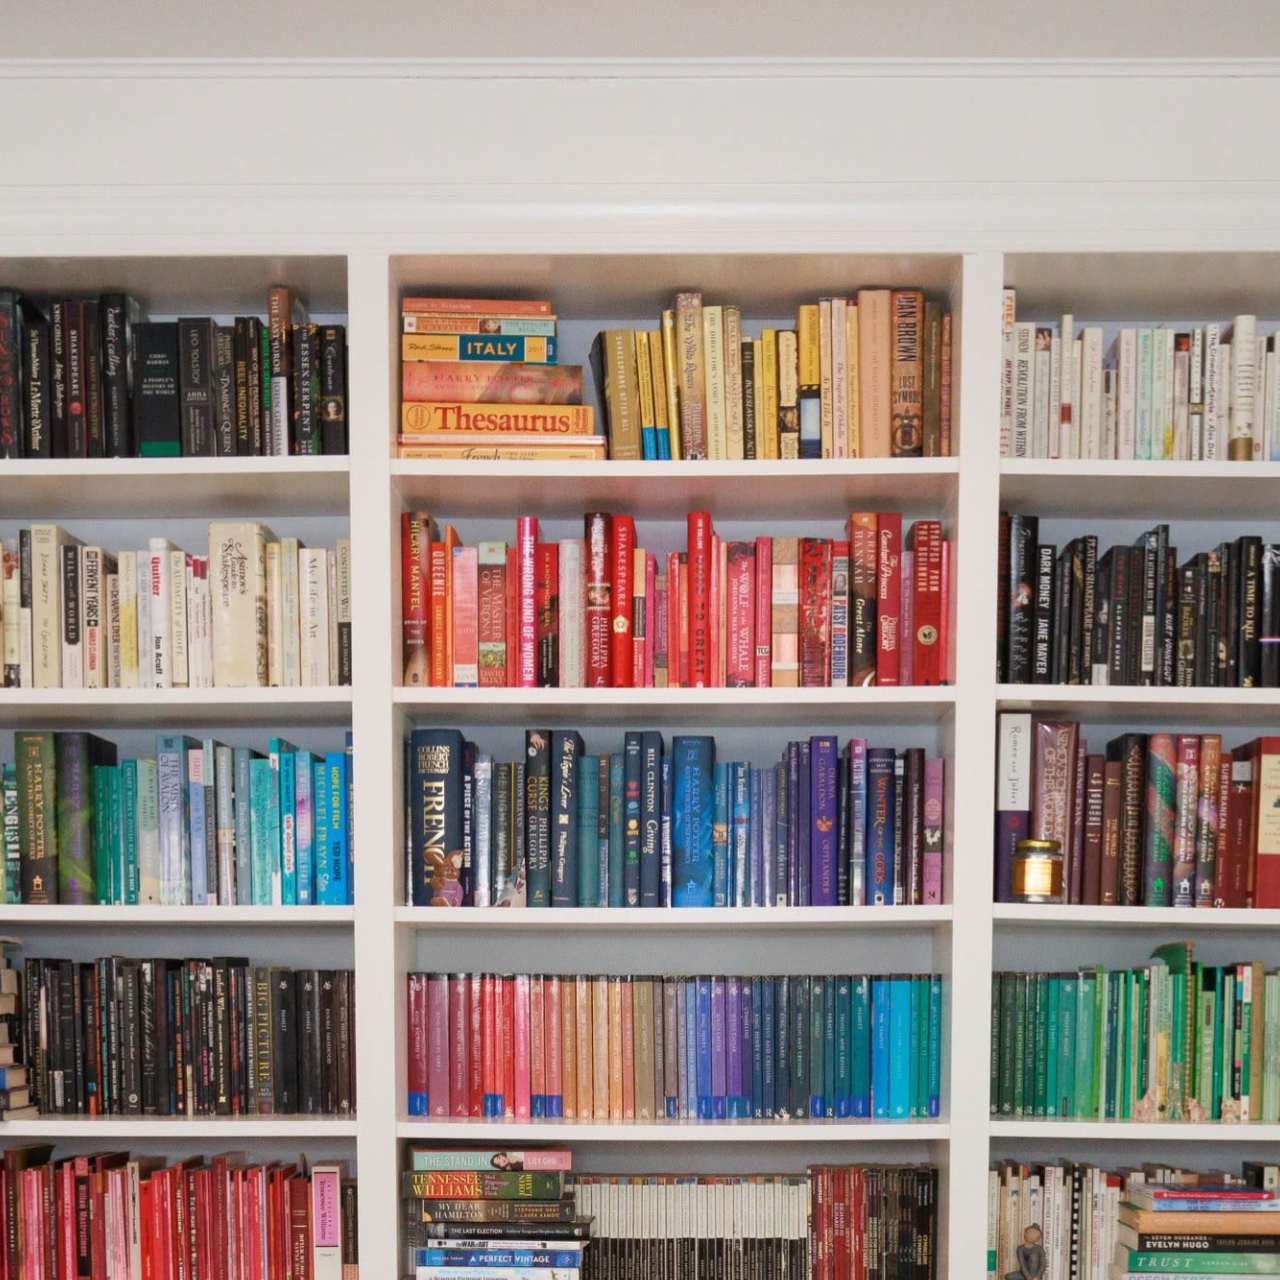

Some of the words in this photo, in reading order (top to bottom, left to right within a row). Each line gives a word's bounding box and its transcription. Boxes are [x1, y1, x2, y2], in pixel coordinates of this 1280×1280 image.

[898, 296, 917, 319] DAN
[190, 329, 200, 346] LEO
[272, 317, 280, 343] LAST
[897, 322, 918, 363] BROWN
[70, 330, 80, 397] SHAKESPEARE
[272, 344, 281, 375] JUROR
[301, 343, 312, 378] ESSEX
[466, 341, 518, 356] ITALY
[191, 349, 201, 385] TOLSTOY
[237, 361, 248, 384] REEL
[1016, 359, 1030, 404] REVOLUTION
[238, 387, 249, 441] INEQUALITY
[302, 381, 313, 433] SERPENT
[434, 405, 570, 434] Thesaurus
[1016, 407, 1029, 429] FROM
[1014, 430, 1028, 459] WITHIN
[410, 520, 421, 560] HILARY
[1085, 538, 1097, 571] PLAYING
[67, 551, 77, 581] WILL
[431, 550, 445, 597] QUEENIE
[617, 526, 627, 609] SHAKESPEARE
[854, 530, 864, 585] HANNAH
[866, 530, 876, 585] KRISTIN
[1039, 548, 1053, 574] DARK
[86, 560, 100, 594] FERVENT
[151, 556, 162, 597] Quitter
[410, 564, 422, 611] MANTEL
[492, 568, 504, 589] THE
[523, 560, 535, 596] WRONG
[929, 570, 940, 593] FROM
[1038, 575, 1052, 609] MONEY
[1245, 579, 1257, 605] TIME
[86, 594, 100, 619] YEARS
[481, 590, 493, 637] VERONA
[493, 592, 505, 641] MASTER
[523, 598, 535, 623] KIND
[695, 602, 704, 622] TO
[832, 600, 847, 626] PATSY
[854, 598, 866, 626] Great
[1083, 573, 1096, 630] SHAKESPEARE
[1245, 606, 1256, 619] TO
[67, 601, 77, 641] WORLD
[310, 623, 321, 641] Art
[523, 625, 535, 639] OF
[1037, 618, 1049, 643] JANE
[1165, 613, 1175, 637] KURT
[1241, 619, 1256, 642] KILL
[591, 616, 600, 669] GREGORY
[599, 616, 608, 669] PHILIPPA
[695, 629, 705, 675] GREAT
[739, 626, 749, 672] WHALE
[832, 627, 847, 681] RODENBURG
[854, 628, 866, 655] Alone
[523, 642, 535, 681] WOMEN
[1036, 643, 1049, 675] MAYER
[1163, 638, 1174, 683] VONNEGUT
[646, 748, 655, 769] BILL
[34, 763, 44, 810] HARRY
[464, 784, 472, 809] PIECE
[527, 776, 538, 812] CURSE
[538, 776, 549, 812] KING'S
[646, 771, 655, 813] CLINTON
[874, 776, 887, 827] WINTER
[1219, 764, 1230, 831] SUBTERRANEAN
[34, 814, 45, 861] POTTER
[333, 841, 341, 857] TED
[464, 835, 473, 869] ACTION
[528, 816, 538, 871] GREGORY
[538, 816, 548, 871] PHILIPPA
[642, 819, 658, 855] Giving
[1218, 832, 1228, 851] FIRE
[333, 858, 342, 882] HOPE
[256, 982, 268, 1001] BIG
[257, 1012, 269, 1082] PICTURE
[411, 1185, 483, 1197] WILLIAMS
[412, 1174, 482, 1184] TENNESSEE
[434, 1210, 483, 1220] HAMILTON
[479, 1255, 512, 1264] PERFECT
[514, 1255, 551, 1264] VINTAGE
[1145, 1240, 1181, 1250] EVELYN
[1182, 1240, 1209, 1250] HUGO
[1136, 1256, 1194, 1268] TRUST
